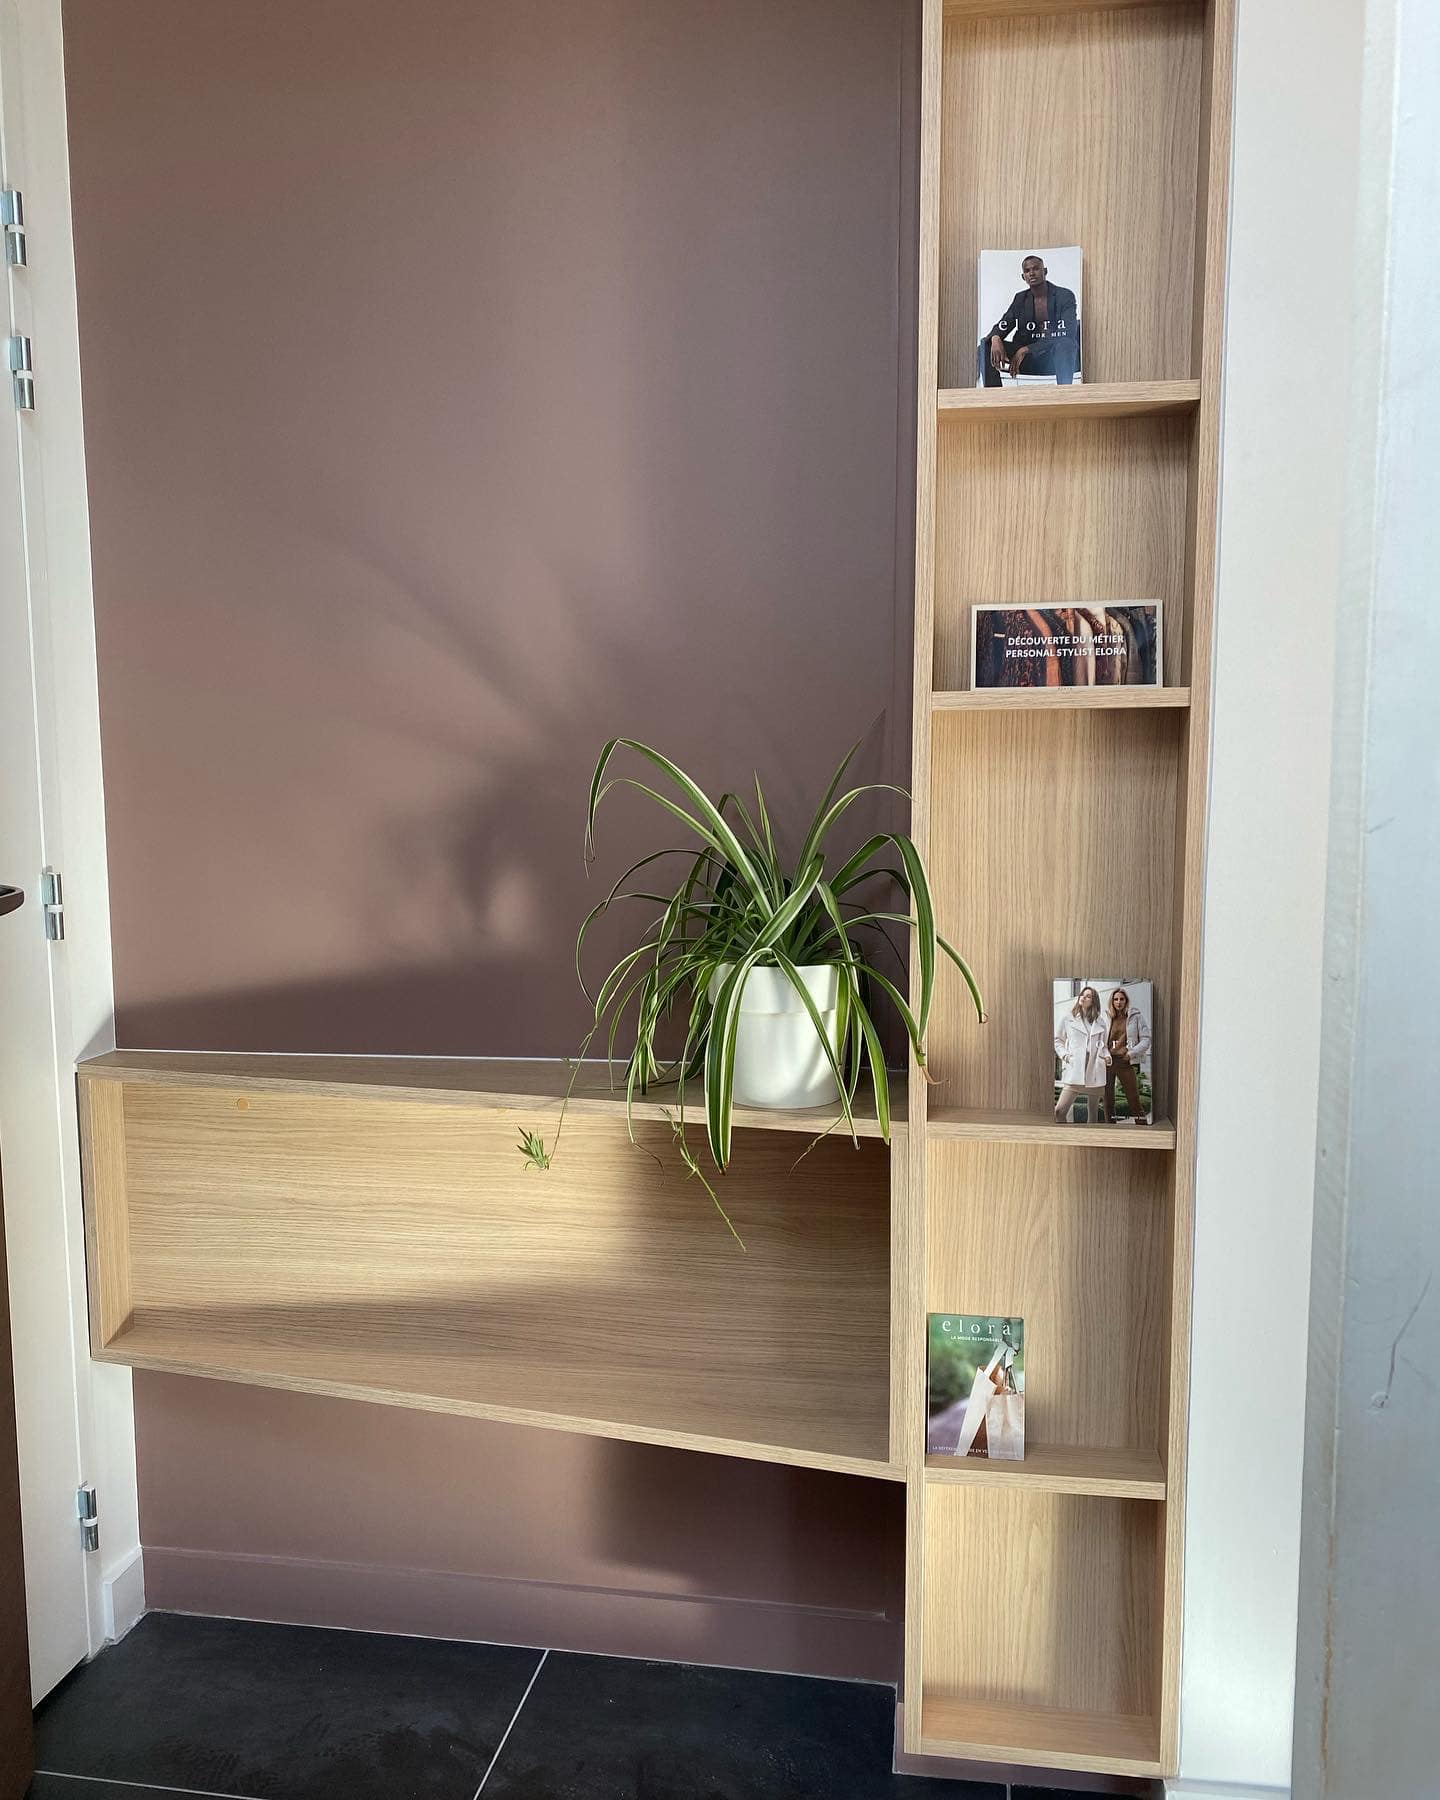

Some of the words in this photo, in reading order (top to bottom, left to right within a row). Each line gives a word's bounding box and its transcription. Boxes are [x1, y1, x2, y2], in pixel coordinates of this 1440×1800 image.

[998, 318, 1066, 331] elora
[1008, 635, 1071, 646] DÉCOUVERTE
[1072, 635, 1087, 644] DU
[1089, 633, 1124, 644] MÉTIER
[1005, 649, 1055, 658] PERSONAL
[1056, 648, 1092, 657] STYLIST
[1095, 647, 1127, 656] ELORA
[942, 1319, 1011, 1336] elora
